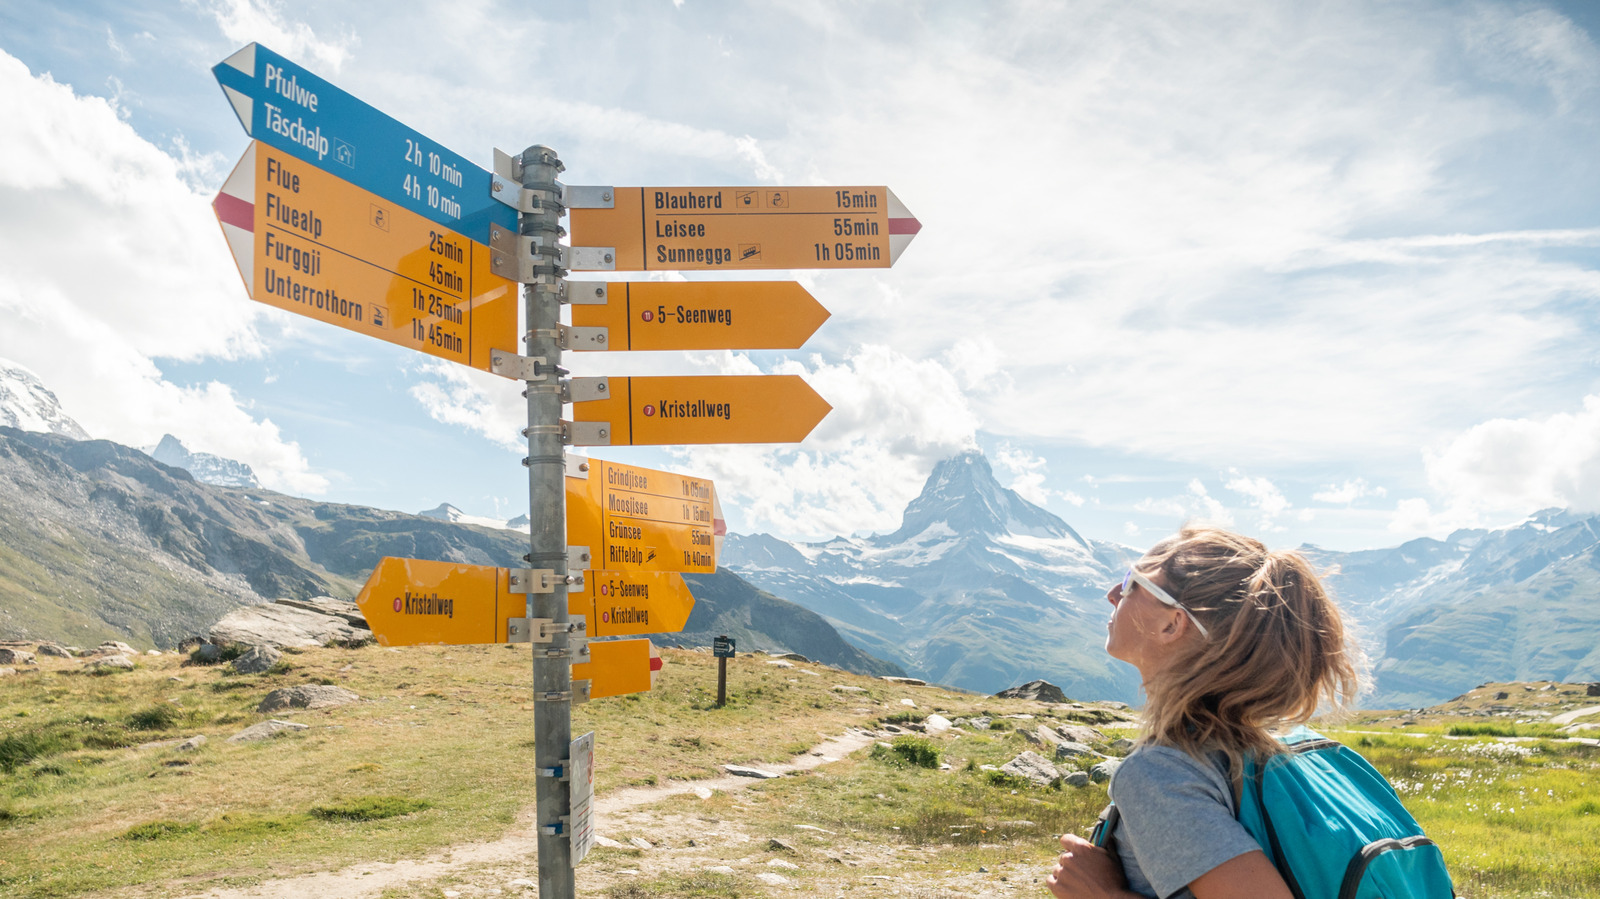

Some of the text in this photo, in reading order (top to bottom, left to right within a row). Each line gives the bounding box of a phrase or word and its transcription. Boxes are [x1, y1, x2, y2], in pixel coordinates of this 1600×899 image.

[265, 63, 318, 112] Pfulwe
[264, 102, 329, 160] Täschalp
[267, 157, 300, 194] Flue
[655, 191, 722, 209] Blauherd
[266, 192, 322, 239] Fluealp
[656, 220, 705, 237] Leisee
[265, 232, 321, 276] Furggji
[657, 244, 731, 264] Sunnegga
[814, 243, 830, 261] 1h
[265, 267, 362, 322] Unterrothorn
[413, 288, 424, 311] 1h
[658, 305, 732, 325] 5-Seenweg
[412, 318, 424, 342] 1h
[659, 400, 731, 420] Kristallweg
[608, 466, 648, 489] Grindjisee
[608, 493, 648, 516] Moosjisee
[610, 521, 642, 540] Grünsee
[610, 545, 643, 566] Riffelalp
[610, 580, 648, 599] 5-Seenweg
[405, 592, 453, 618] Kristallweg
[611, 606, 648, 625] Kristallweg
